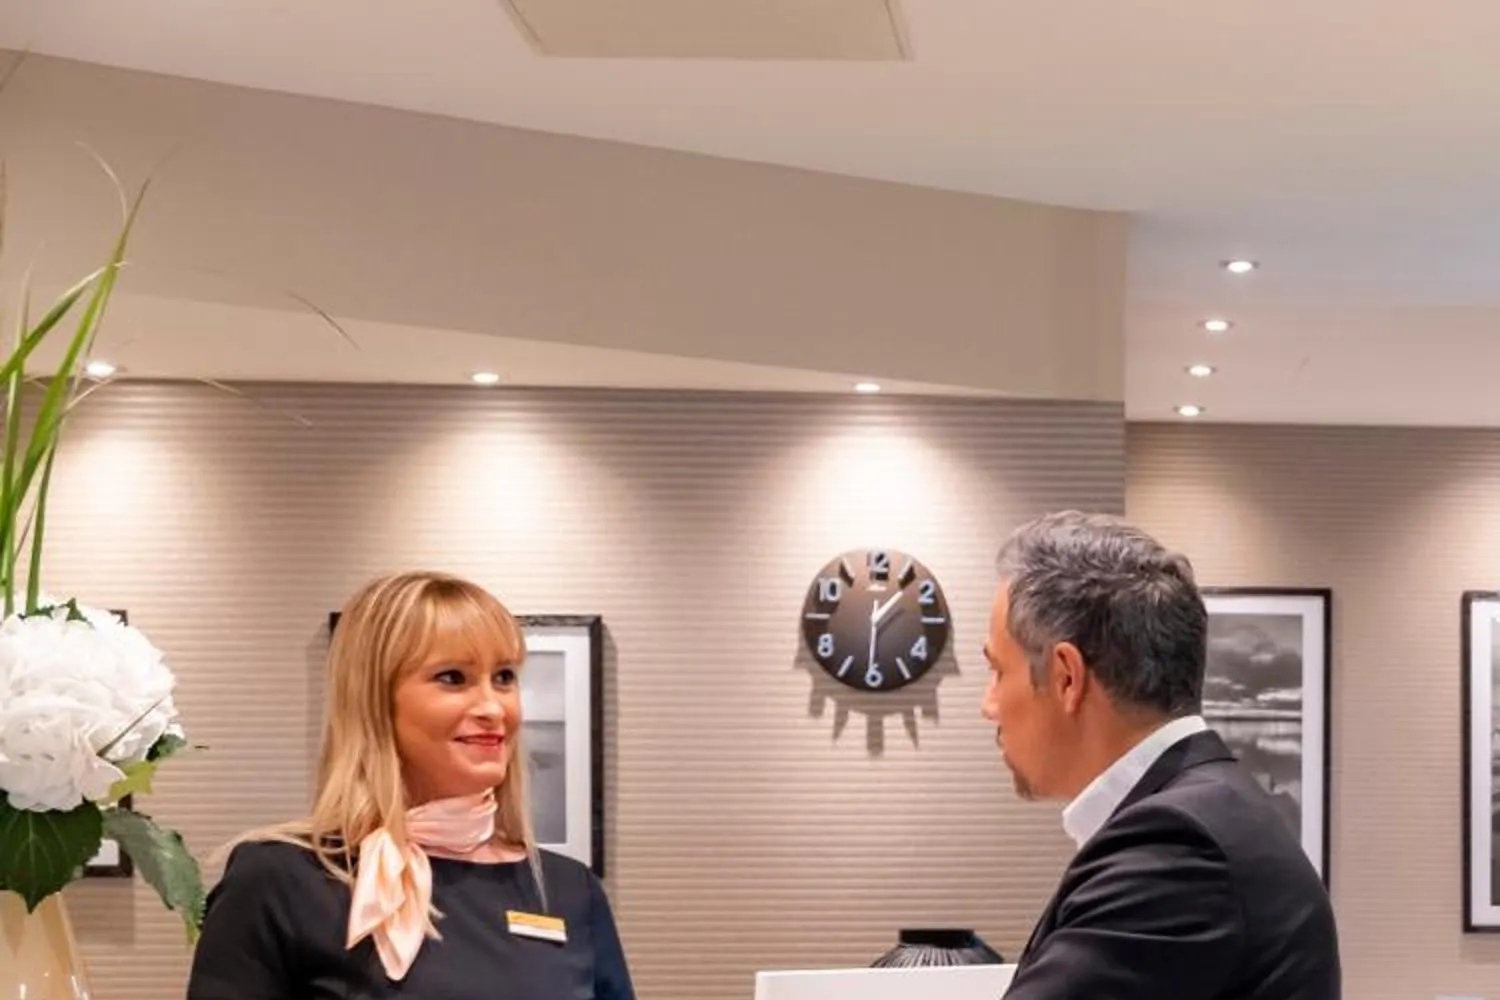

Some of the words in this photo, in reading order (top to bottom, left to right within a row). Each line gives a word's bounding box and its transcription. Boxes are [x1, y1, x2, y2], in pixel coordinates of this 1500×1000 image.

[868, 549, 889, 572] 12
[819, 577, 842, 602] 10
[918, 580, 936, 604] 2
[817, 633, 834, 657] 8
[910, 635, 928, 661] 4
[865, 663, 883, 687] 6
